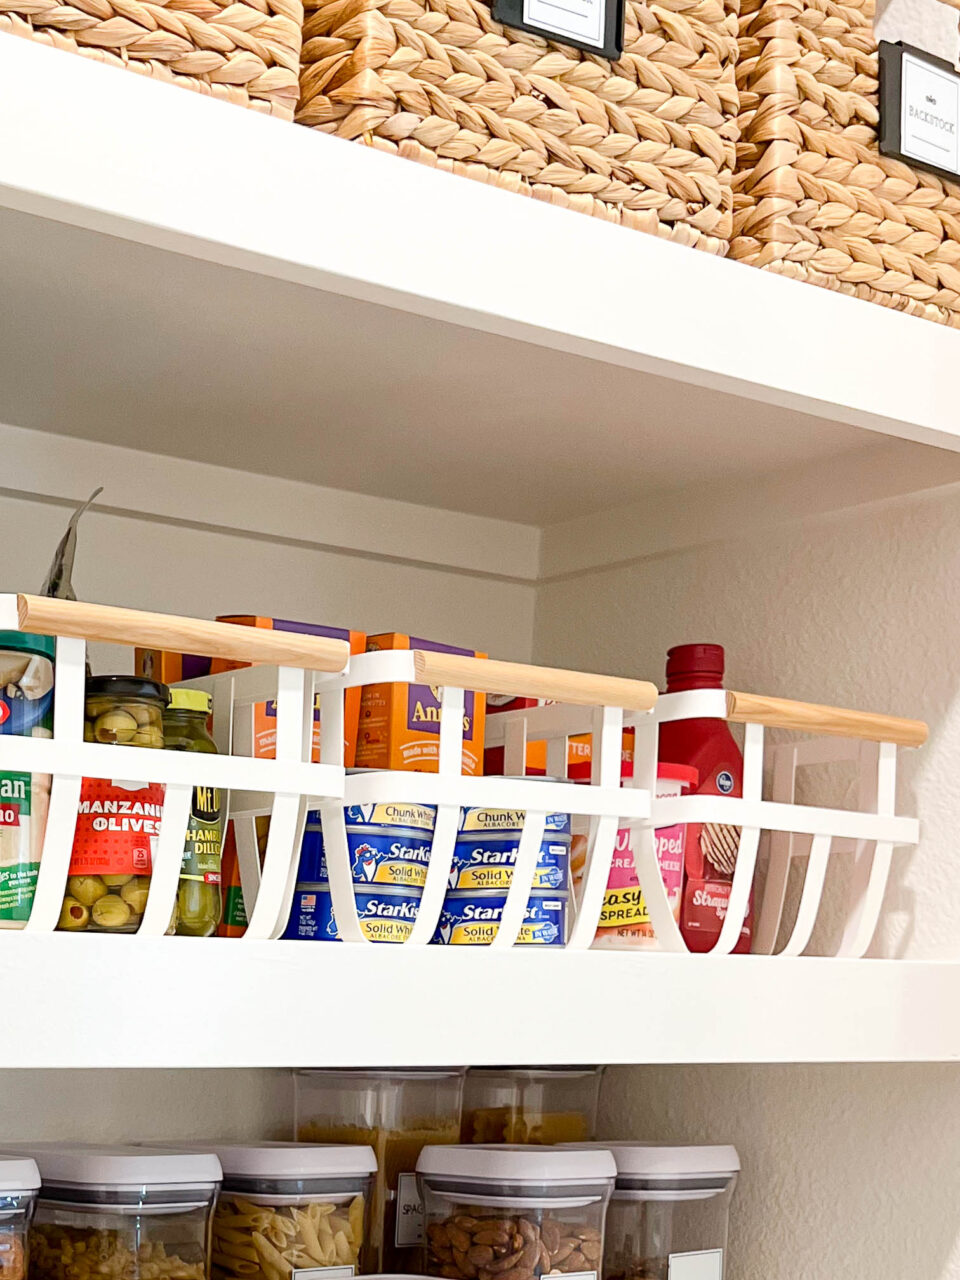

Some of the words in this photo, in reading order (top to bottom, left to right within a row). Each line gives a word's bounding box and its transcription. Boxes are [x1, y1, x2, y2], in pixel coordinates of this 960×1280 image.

[908, 105, 955, 134] BACKSTOCK
[385, 806, 416, 819] Chunk
[477, 811, 514, 822] Chunk
[388, 865, 413, 878] Solid
[471, 869, 502, 881] Solid
[364, 900, 420, 919] StarKis
[462, 905, 539, 920] Starst
[366, 922, 393, 935] Solid
[463, 926, 493, 937] Solid
